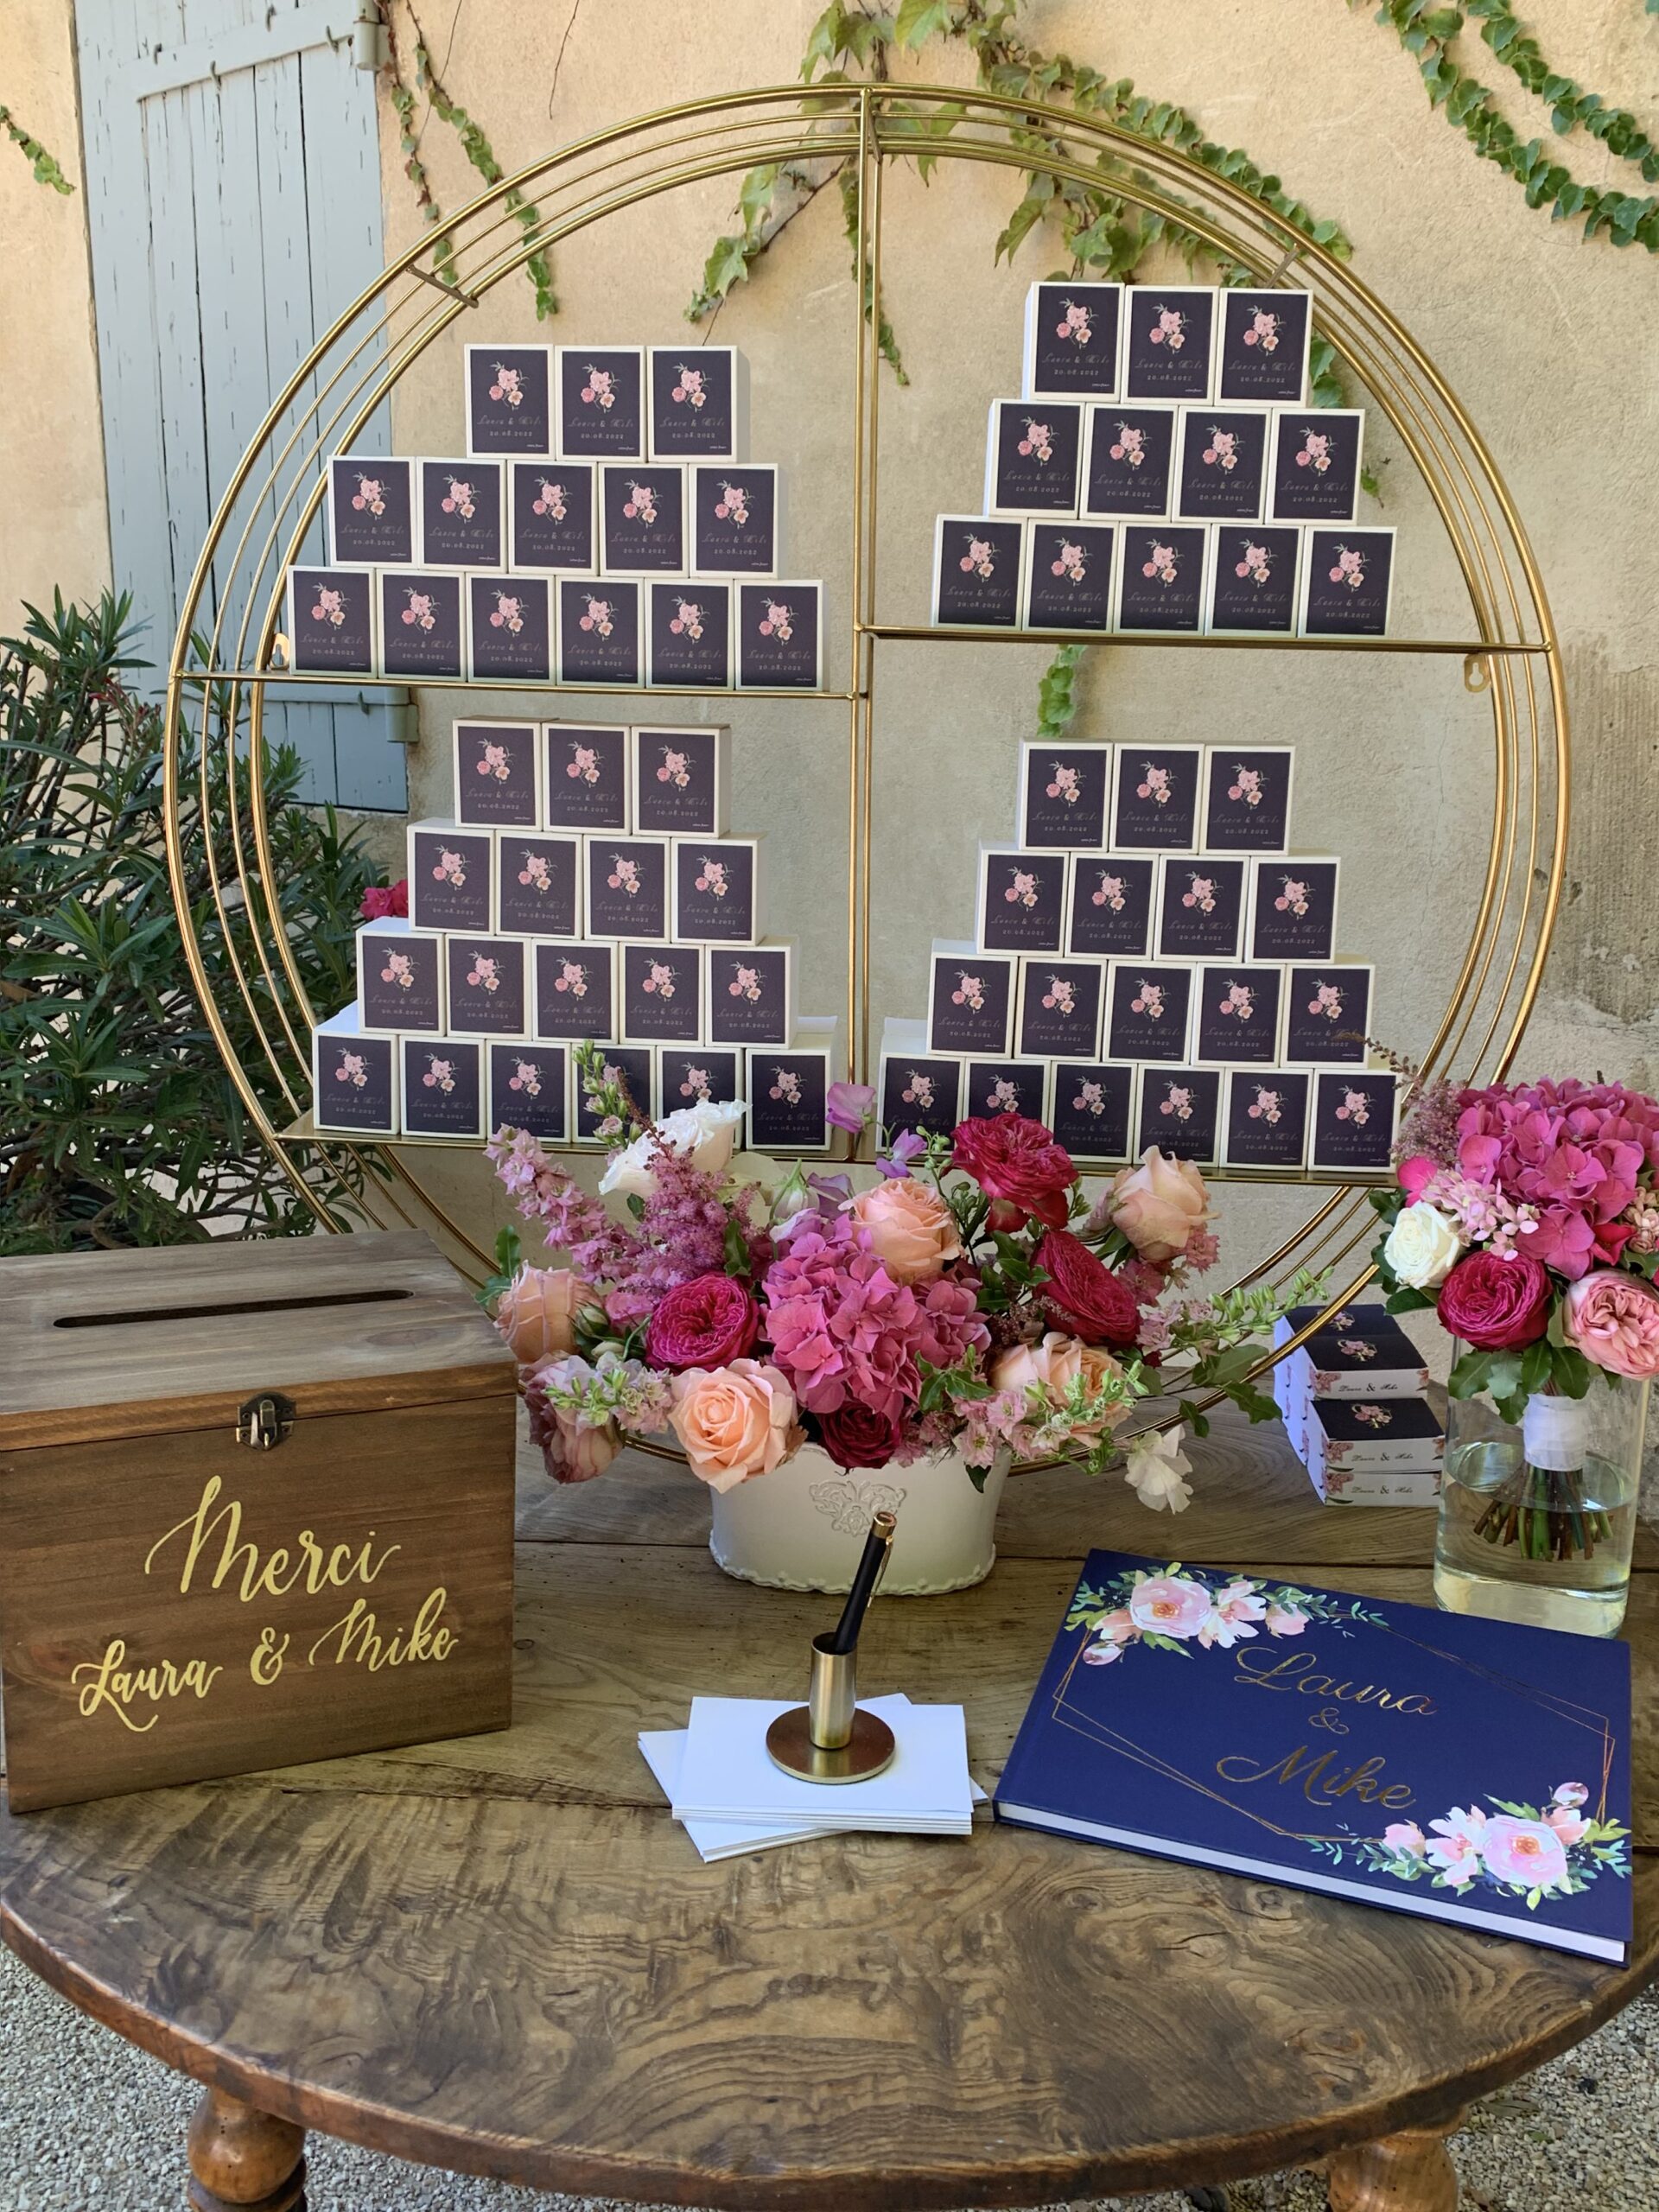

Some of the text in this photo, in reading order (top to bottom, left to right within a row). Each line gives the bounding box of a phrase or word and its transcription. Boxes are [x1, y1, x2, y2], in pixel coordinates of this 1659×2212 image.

[144, 1475, 401, 1602] Merci
[72, 1587, 459, 1732] Laura & Mike
[1234, 1647, 1437, 1714] Laura
[1308, 1707, 1350, 1734] &
[1217, 1745, 1416, 1809] Mike
